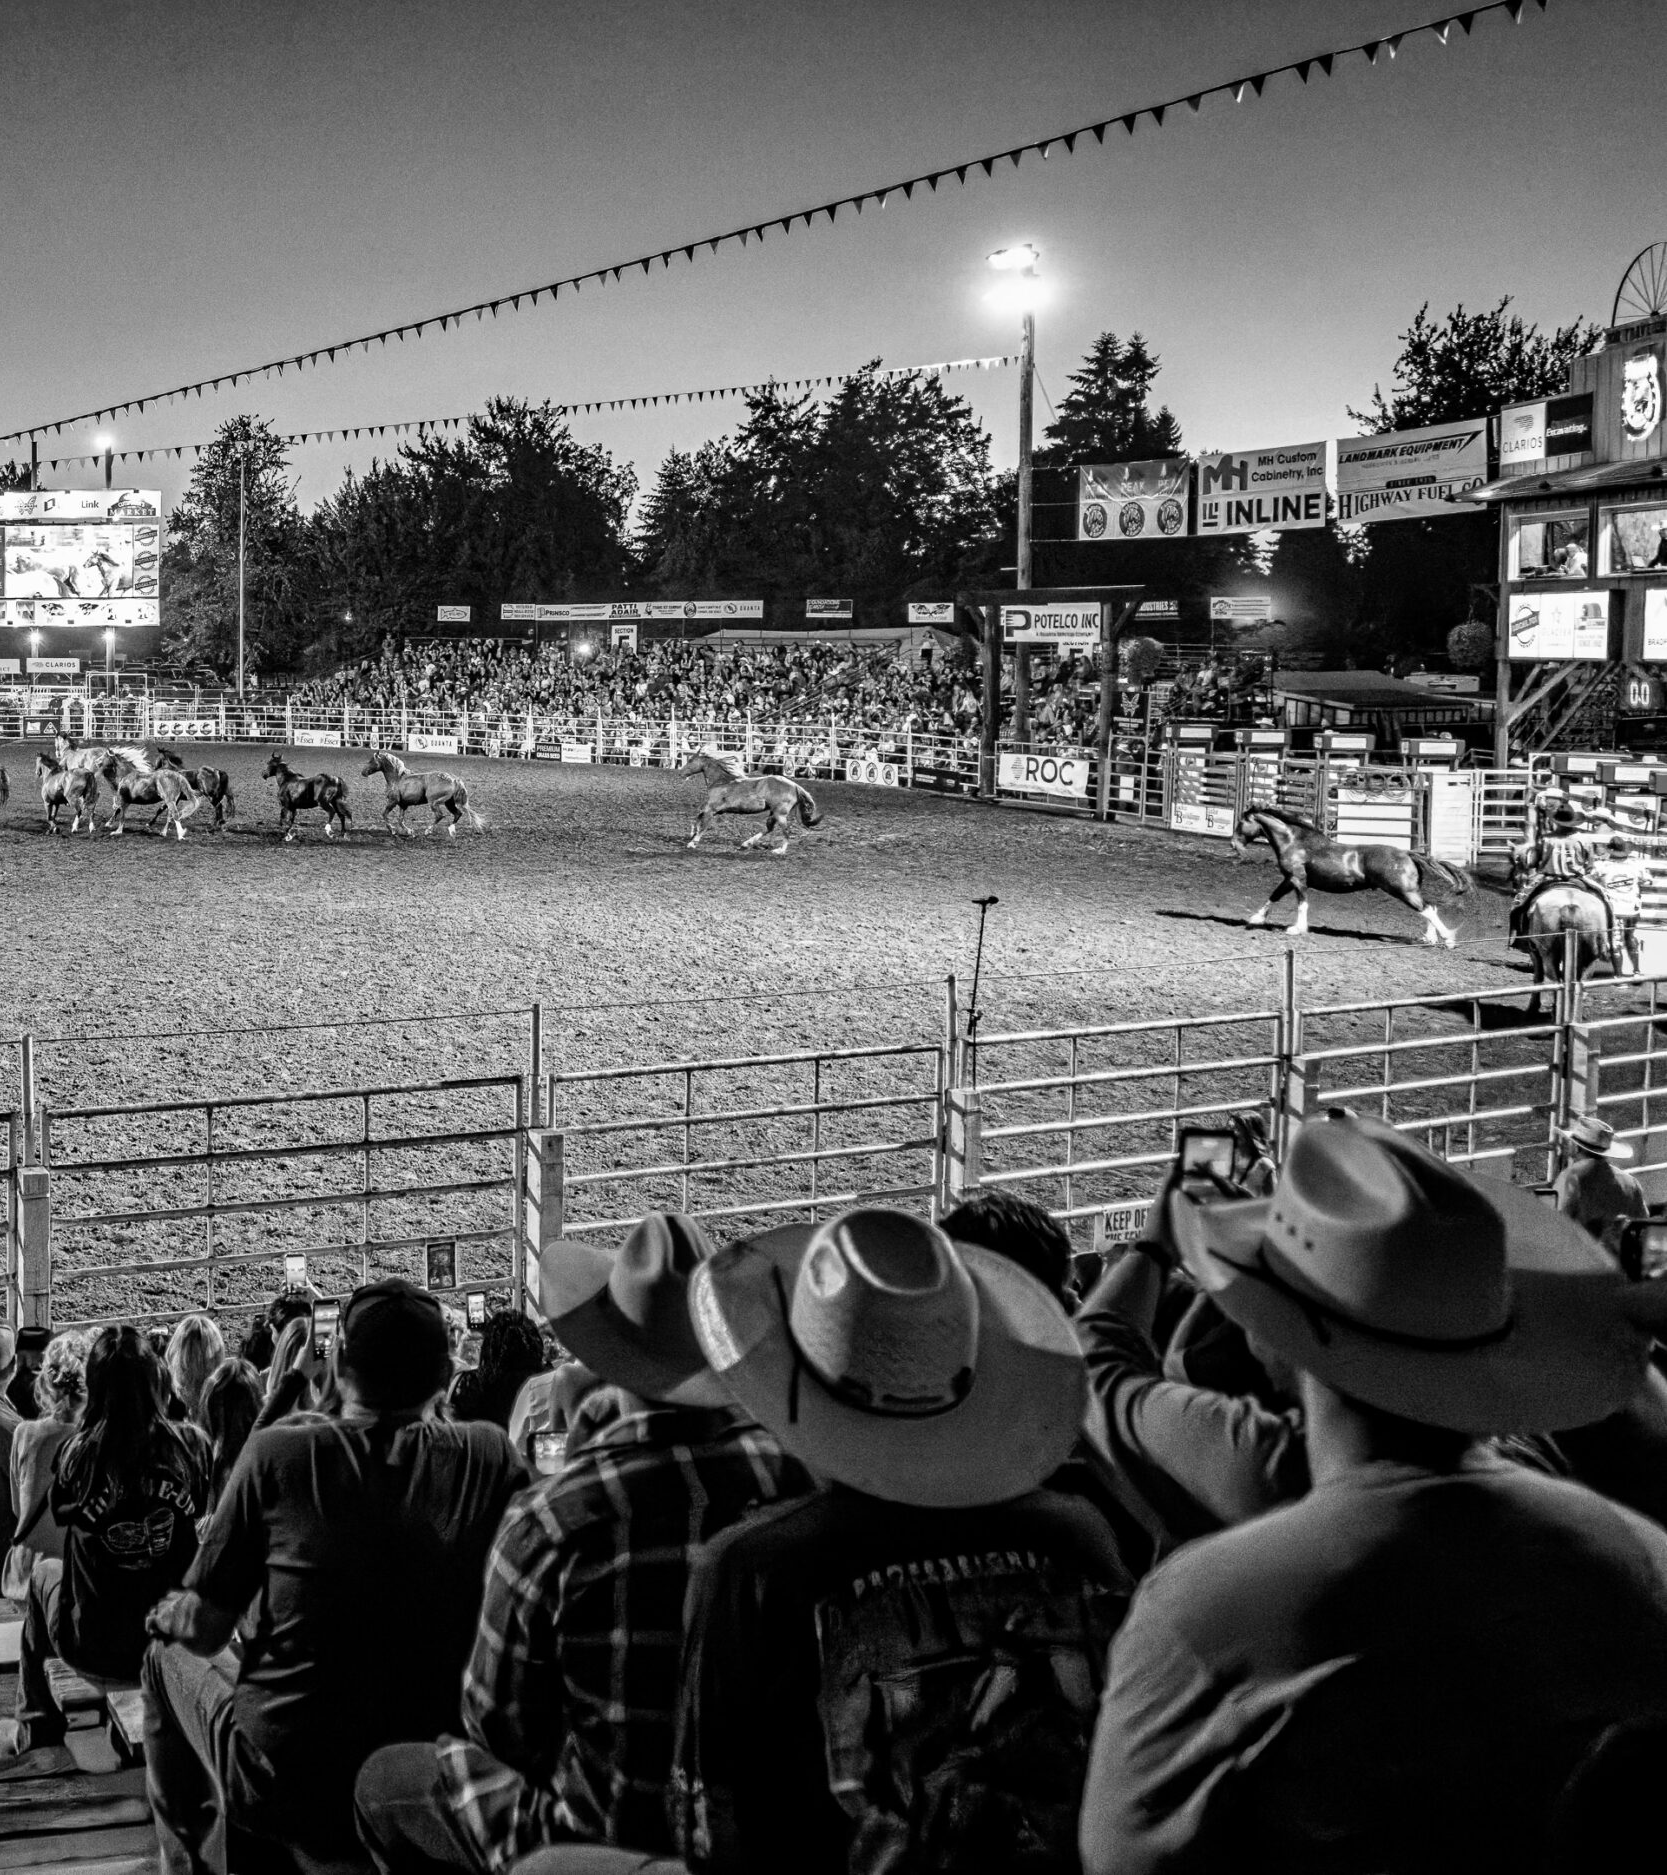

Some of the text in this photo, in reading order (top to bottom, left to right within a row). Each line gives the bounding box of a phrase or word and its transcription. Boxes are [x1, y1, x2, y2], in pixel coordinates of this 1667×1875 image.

[1339, 447, 1400, 464] LANDMARK
[1398, 437, 1466, 457] EQUIPMENT
[1502, 436, 1543, 453] CLARIOS
[1258, 451, 1317, 467] MH Custom
[1251, 465, 1324, 483] Cabinetry, Inc
[81, 500, 99, 509] Link
[1227, 493, 1322, 526] INLINE
[1338, 488, 1413, 520] HIGHWAY
[1417, 484, 1453, 501] FUEL
[109, 508, 155, 516] MARKET
[1034, 612, 1099, 629] POTELCO INC
[537, 745, 560, 753] PREMIUM
[1025, 756, 1075, 786] ROC
[1105, 1210, 1131, 1232] KEEP
